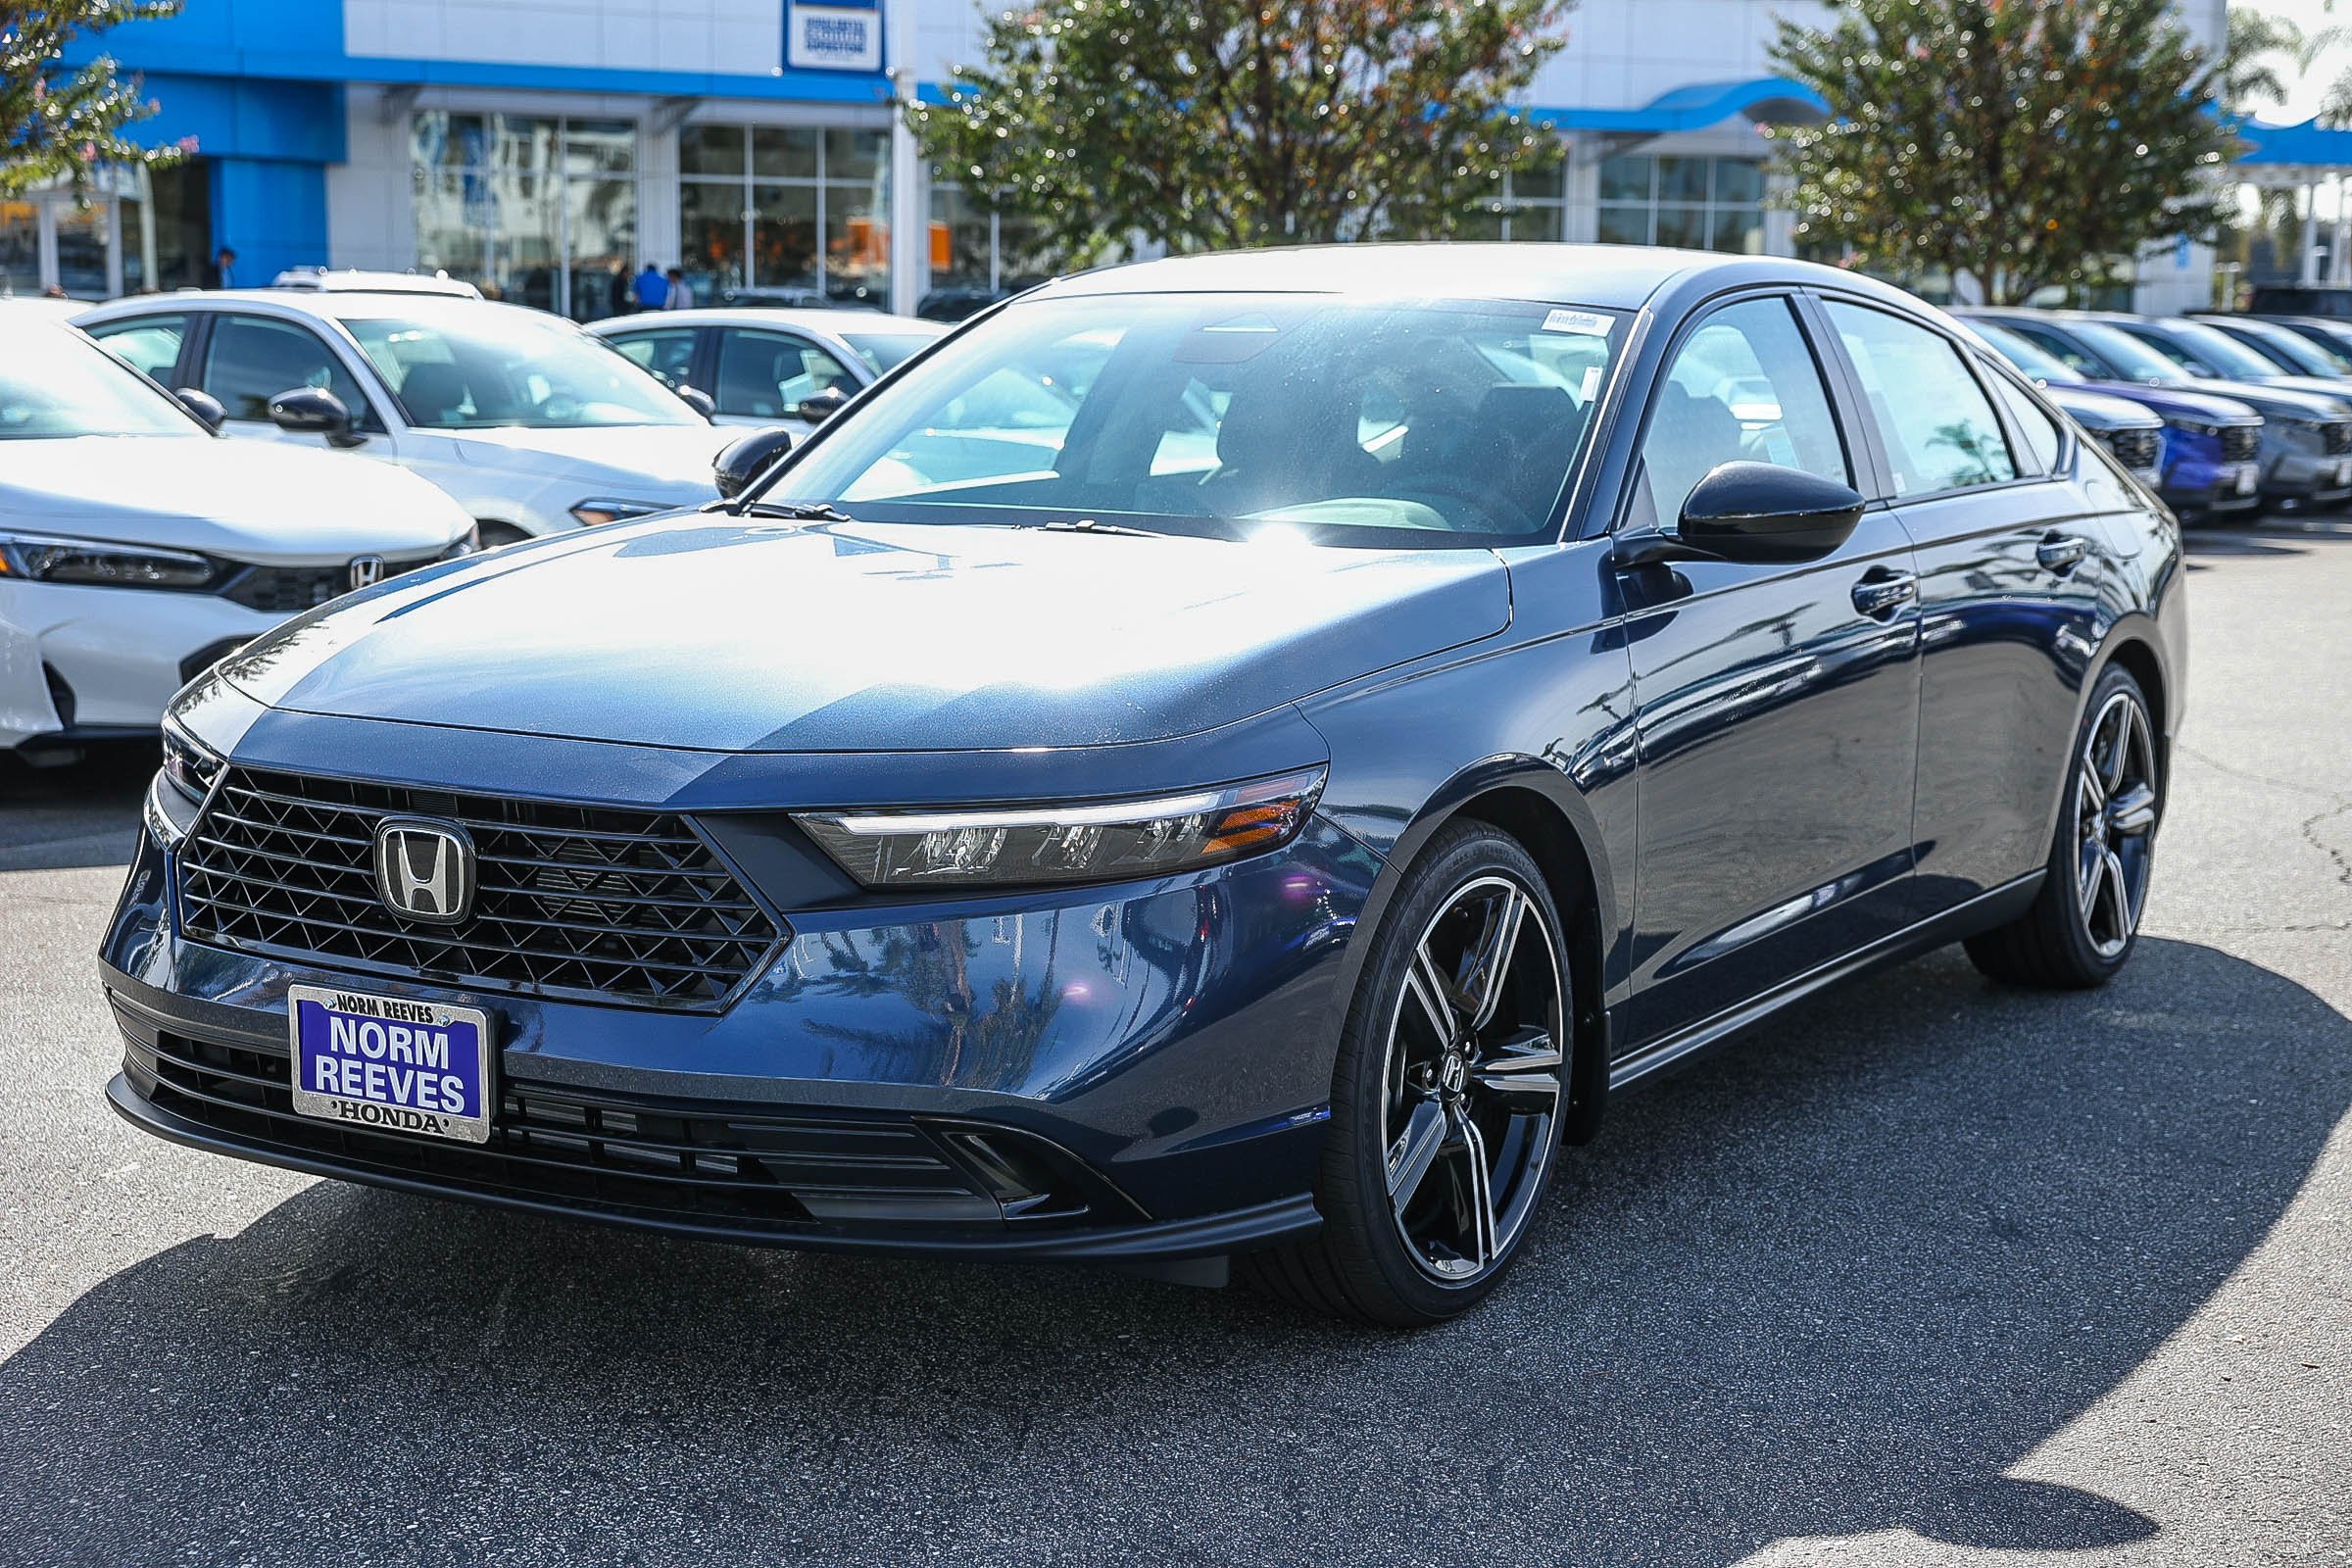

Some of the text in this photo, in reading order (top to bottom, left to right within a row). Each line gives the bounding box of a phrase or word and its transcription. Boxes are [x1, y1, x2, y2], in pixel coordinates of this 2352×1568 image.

[337, 994, 433, 1024] NORM REEVES
[330, 1016, 449, 1069] NORM
[316, 1054, 465, 1113] REEVES
[338, 1100, 445, 1134] HONDA
